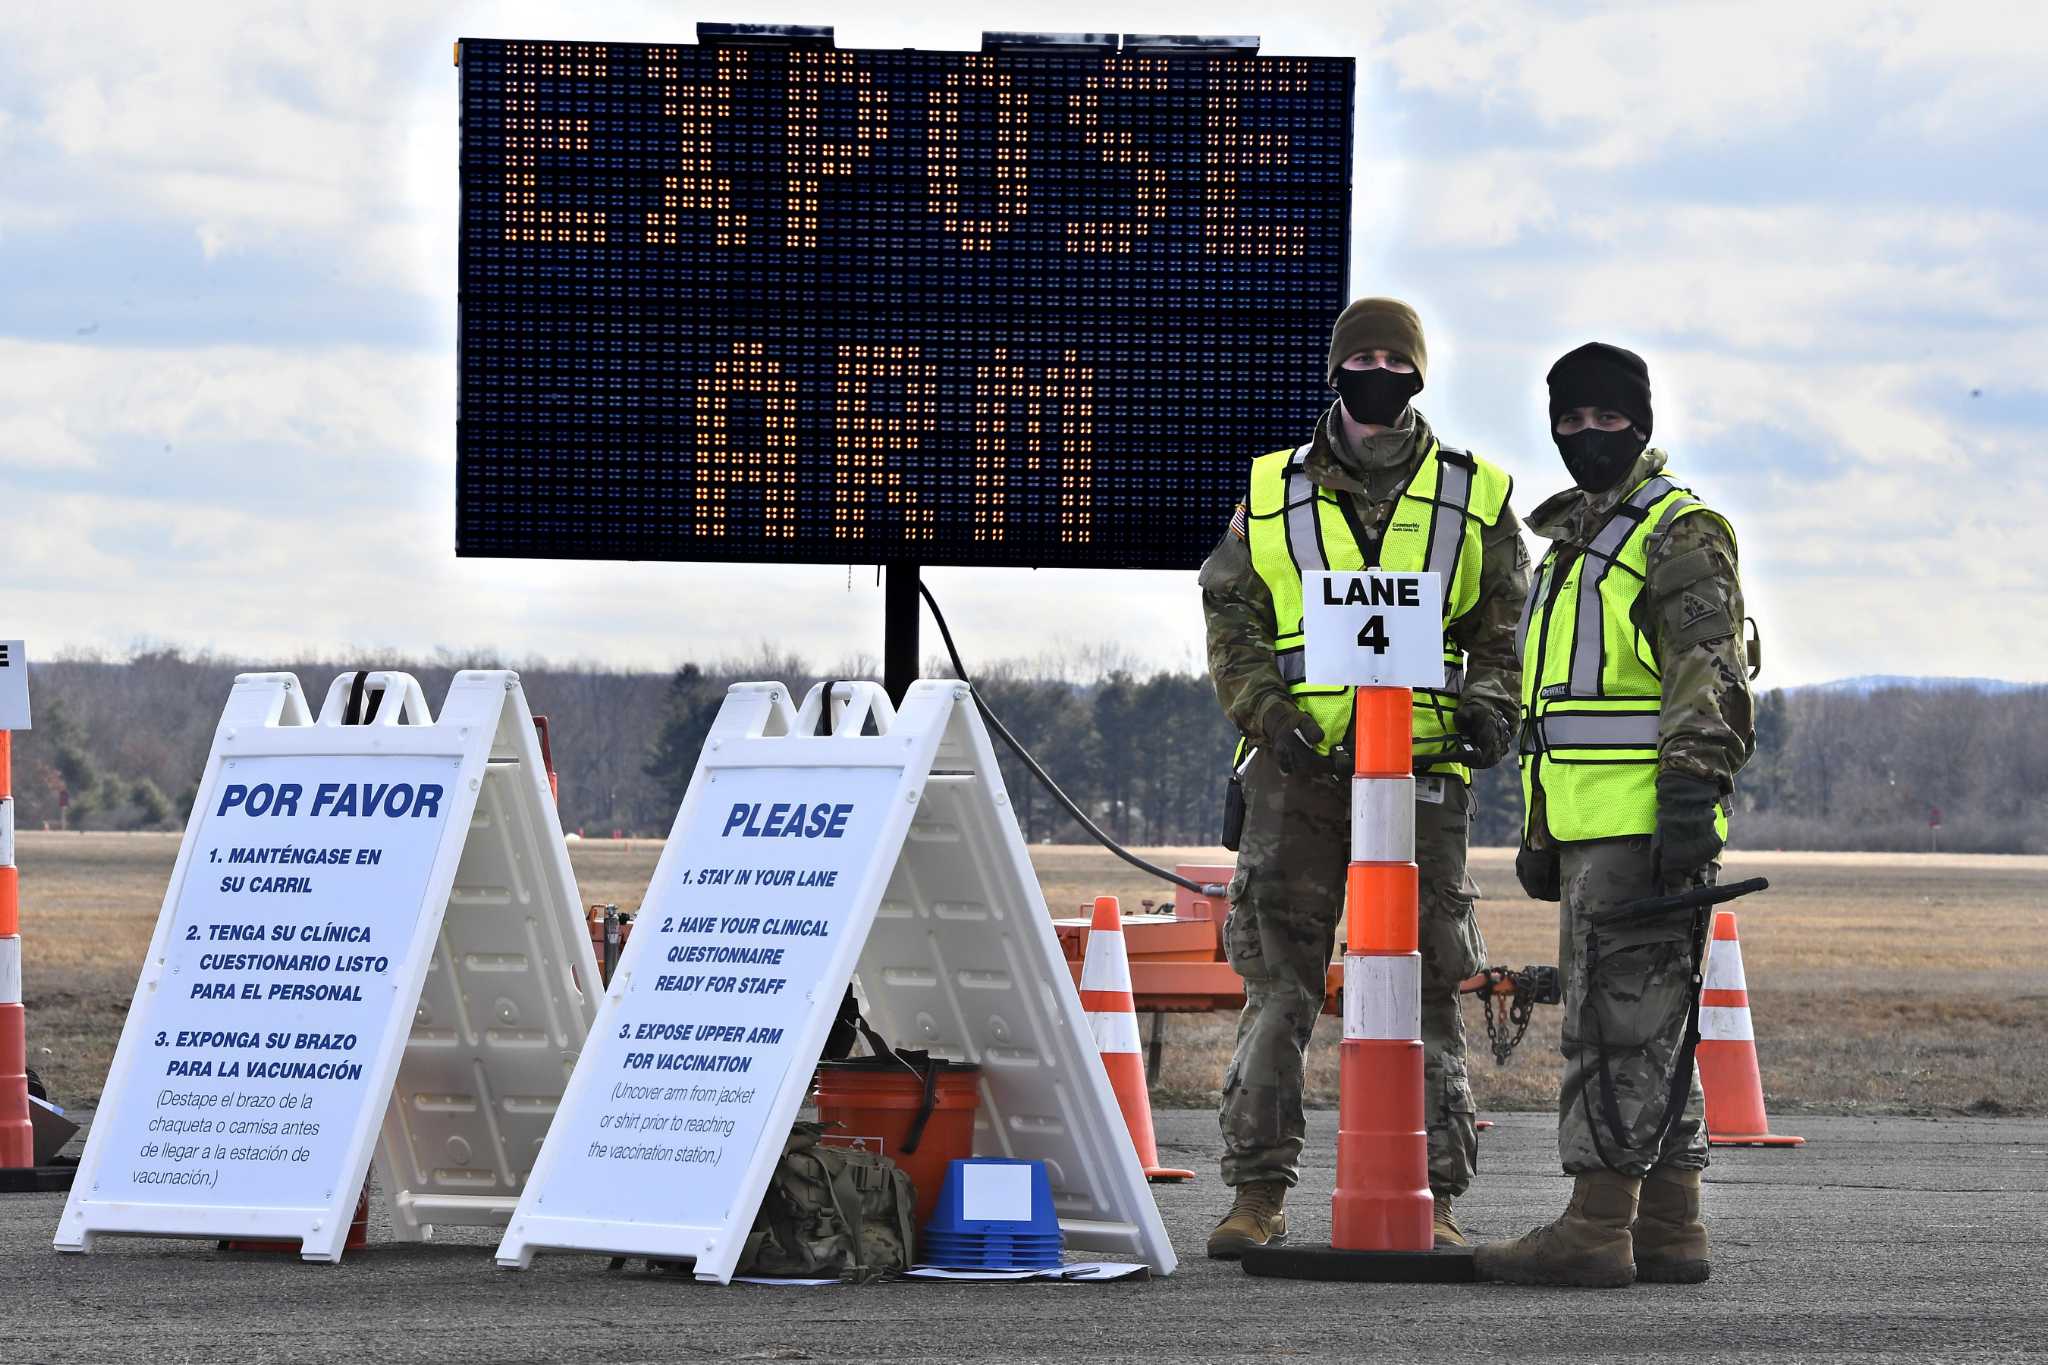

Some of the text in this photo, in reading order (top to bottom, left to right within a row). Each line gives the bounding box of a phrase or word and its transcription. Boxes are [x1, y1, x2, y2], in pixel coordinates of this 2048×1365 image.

[505, 43, 1309, 256] EXPOSE
[695, 341, 1095, 544] ARM
[1323, 577, 1420, 606] LANE
[1357, 615, 1390, 655] 4
[216, 783, 444, 818] POR FAVOR
[721, 803, 854, 839] PLEASE
[209, 844, 382, 865] 1. MANTÉNGASE EN
[220, 876, 313, 893] SU CARRIL
[682, 869, 838, 887] 1. STAY IN YOUR LANE
[185, 921, 371, 943] 2. TENGA SU CLÍNICA
[660, 917, 828, 937] 2. HAVE YOUR CLINICAL
[199, 953, 389, 973] CUESTIONARIO LISTO
[667, 946, 785, 965] QUESTIONNAIRE
[190, 983, 363, 1002] PARA EL PERSONAL
[654, 975, 787, 995] READY FOR STAFF
[154, 1031, 357, 1051] 3. EXPONGA SU BRAZO
[619, 1023, 784, 1044] 3. EXPOSE UPPER ARM
[166, 1059, 363, 1080] PARA LA VACUNACIÓN
[623, 1052, 753, 1073] FOR VACCINATION
[157, 1089, 313, 1110] (Destape el brazo de la
[611, 1082, 755, 1106] (Uncover arm from jacket
[149, 1116, 320, 1136] chaqueta o camisa antes
[600, 1112, 735, 1138] or shirt prior to reaching
[140, 1142, 310, 1162] de llegar a la estación de
[588, 1141, 722, 1167] the vaccination station.)
[133, 1169, 218, 1189] vacunación.)
